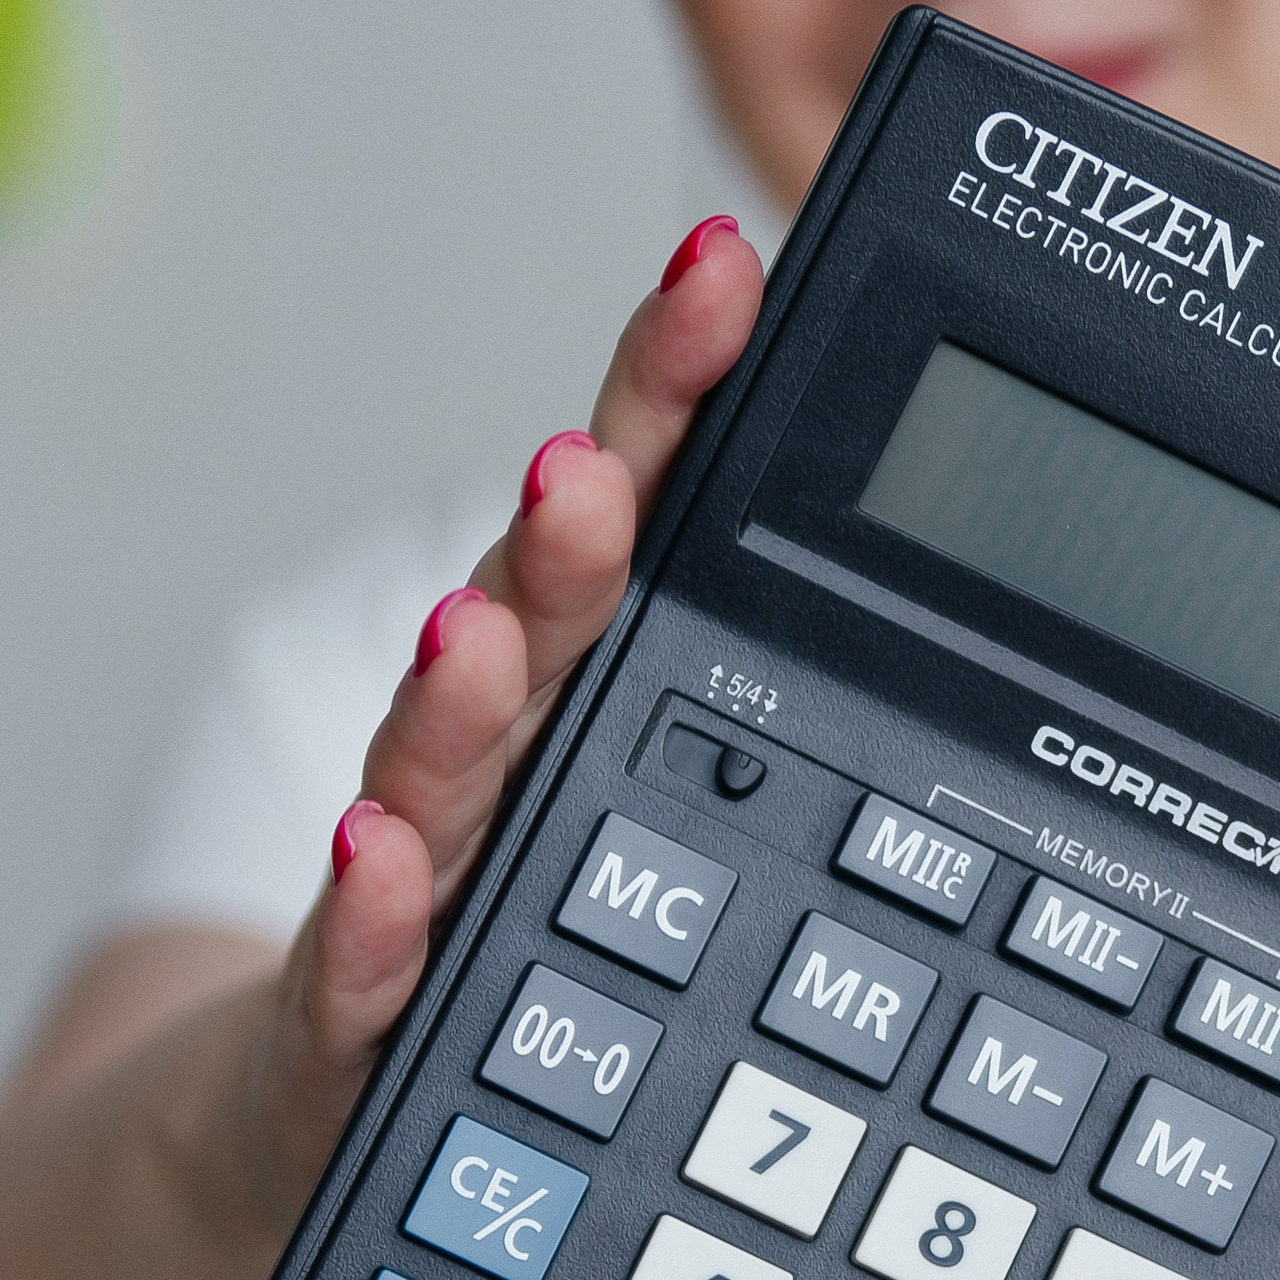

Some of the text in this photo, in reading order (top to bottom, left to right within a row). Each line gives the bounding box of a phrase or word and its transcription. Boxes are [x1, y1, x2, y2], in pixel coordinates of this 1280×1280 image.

[949, 171, 1173, 304] ELECTRONIC
[975, 112, 1264, 289] CITIZEN
[588, 852, 704, 940] MC
[793, 951, 900, 1041] MR
[749, 1109, 812, 1175] 7
[1136, 1119, 1233, 1195] M+
[919, 1201, 976, 1268] 8
